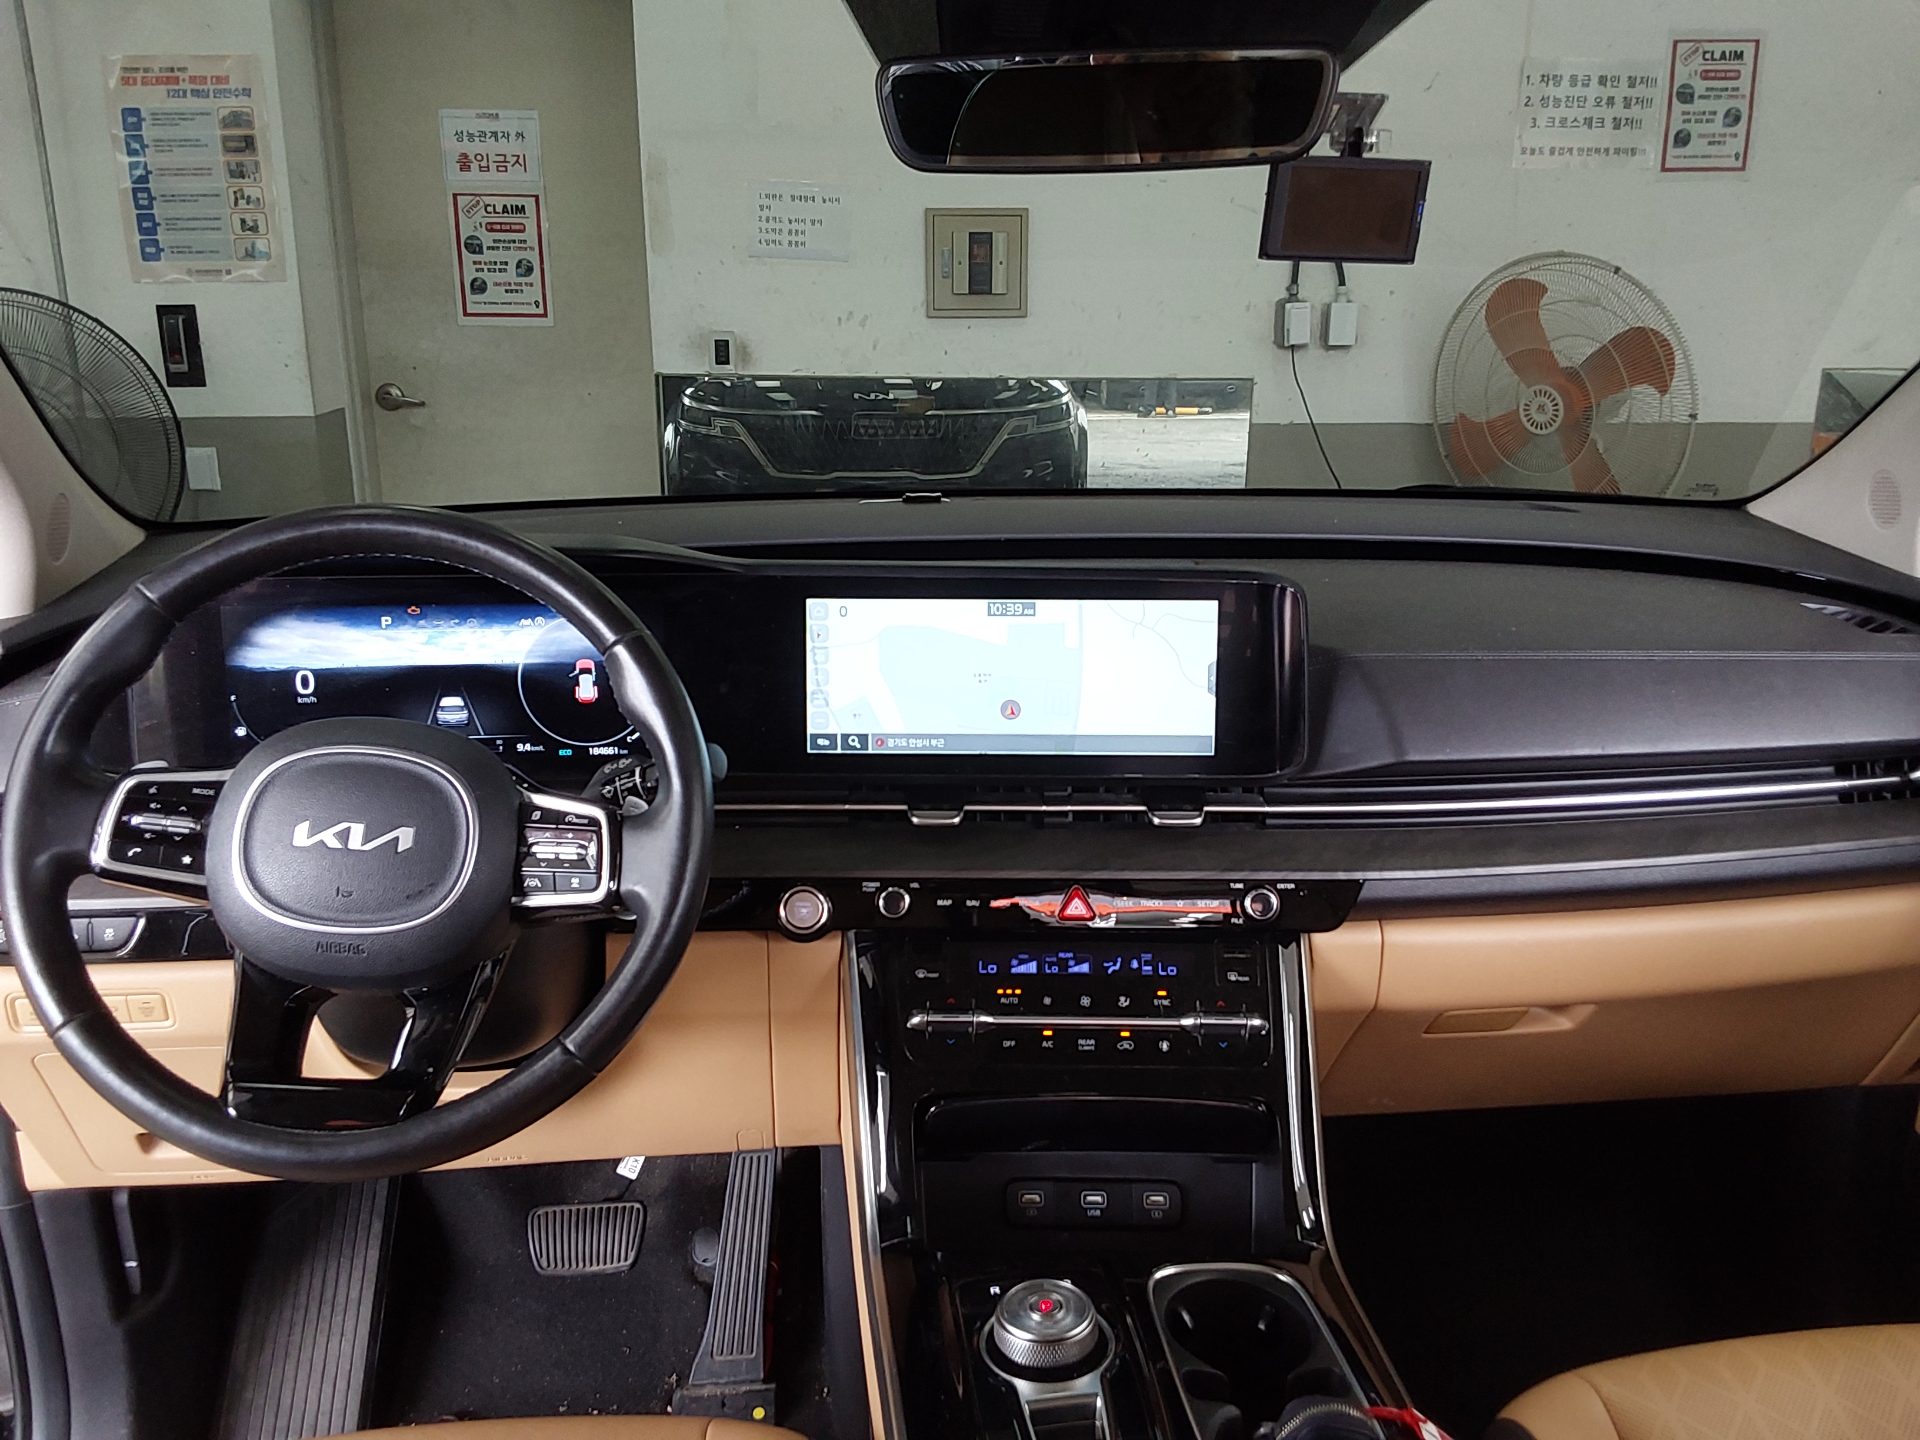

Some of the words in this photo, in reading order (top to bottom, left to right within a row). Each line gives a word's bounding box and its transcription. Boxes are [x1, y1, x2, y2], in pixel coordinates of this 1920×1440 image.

[1702, 50, 1744, 61] CLAIM
[1539, 74, 1563, 87] 차량
[1568, 75, 1591, 88] 등급
[1597, 75, 1620, 88] 확인
[1524, 96, 1534, 107] 2.
[1539, 95, 1587, 109] 성능진단
[1592, 96, 1616, 108] 오류
[1529, 117, 1540, 128] 3.
[1544, 116, 1605, 130] 크로스체크
[454, 130, 510, 144] 성능관계자
[456, 153, 528, 173] 출입금지
[484, 203, 526, 215] CLAIM
[990, 603, 1022, 616] 10:39
[381, 616, 392, 629] P
[295, 670, 315, 695] 0
[516, 743, 531, 752] 9.4
[588, 747, 618, 755] 184661
[192, 787, 215, 796] MODE
[292, 819, 416, 853] KIA
[316, 941, 368, 956] AIRBAG
[978, 960, 997, 974] Lo
[1158, 962, 1177, 976] Lo
[989, 1286, 1000, 1296] R
